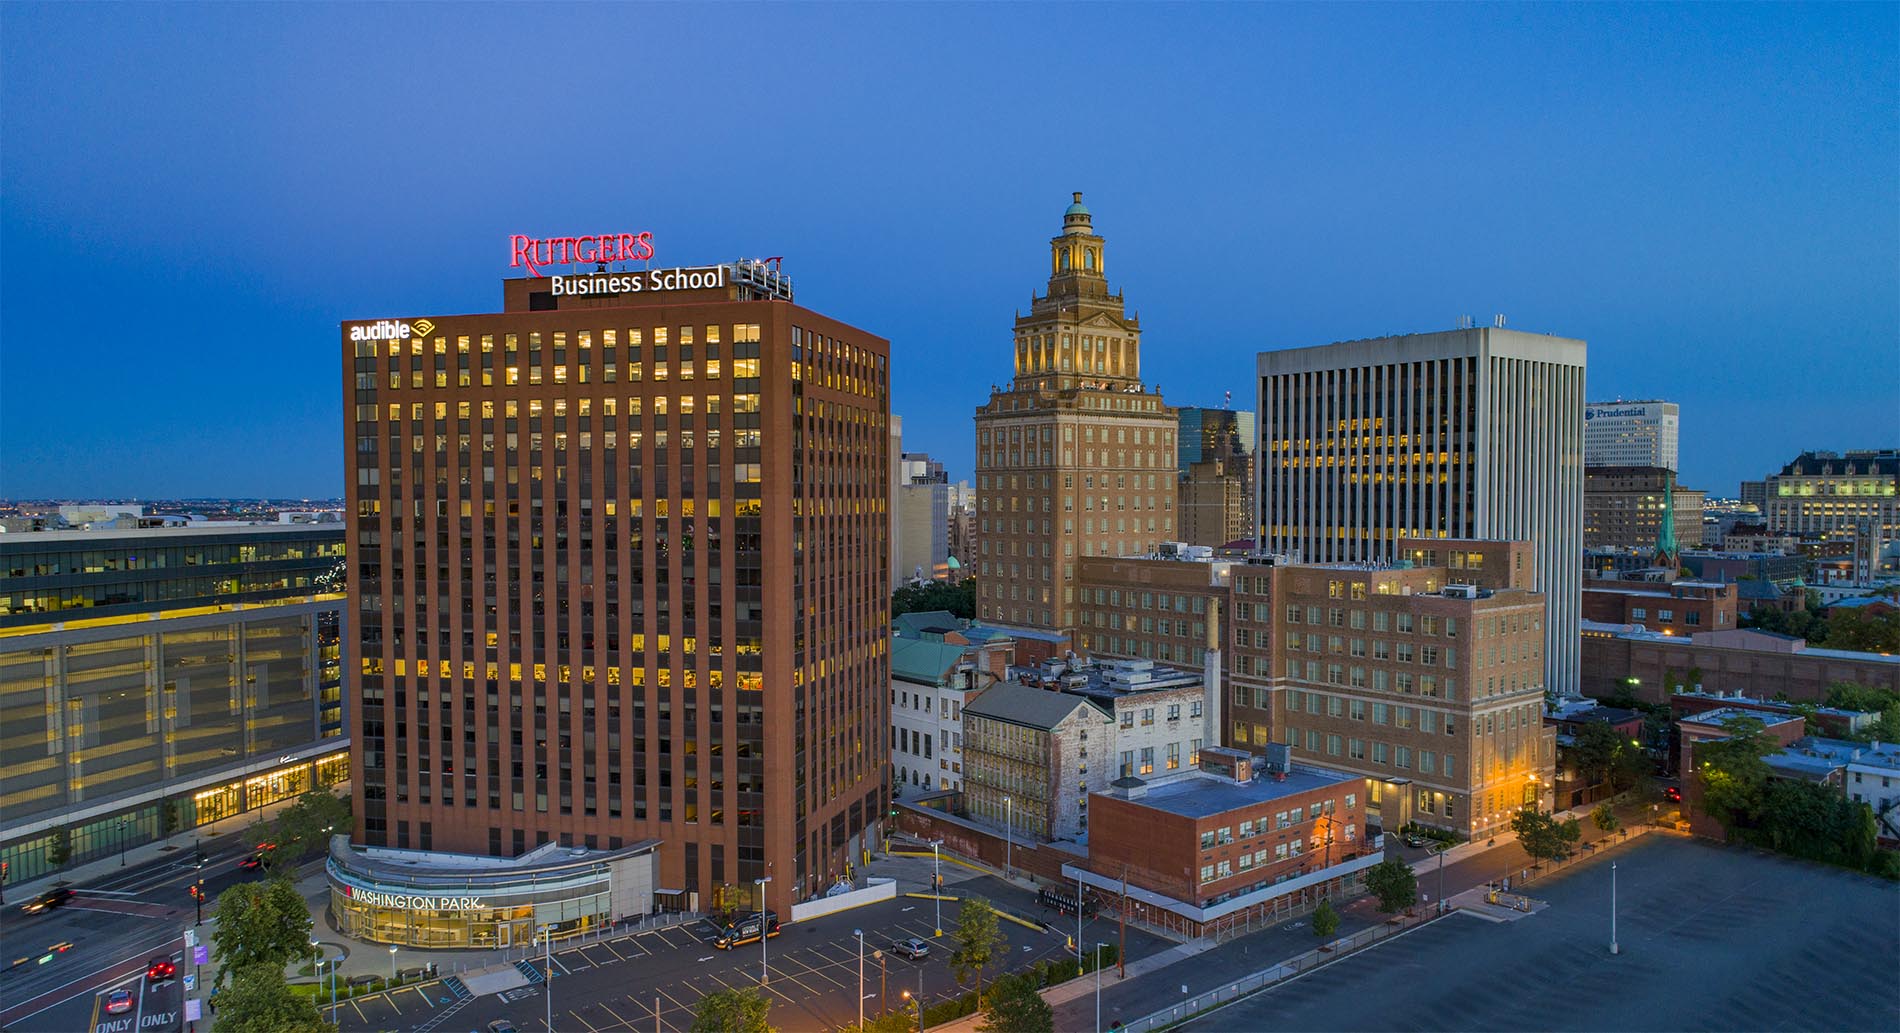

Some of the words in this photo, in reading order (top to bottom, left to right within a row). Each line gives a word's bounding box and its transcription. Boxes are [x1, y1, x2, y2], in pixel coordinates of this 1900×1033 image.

[510, 231, 654, 278] RUTGERS
[551, 272, 642, 296] Business
[650, 264, 724, 291] School
[350, 320, 410, 341] audible
[1596, 407, 1646, 418] Prudential
[351, 887, 435, 909] WASHINGTON
[440, 896, 480, 909] PARK
[96, 1018, 132, 1033] ONLY
[141, 1012, 176, 1027] ONLY
